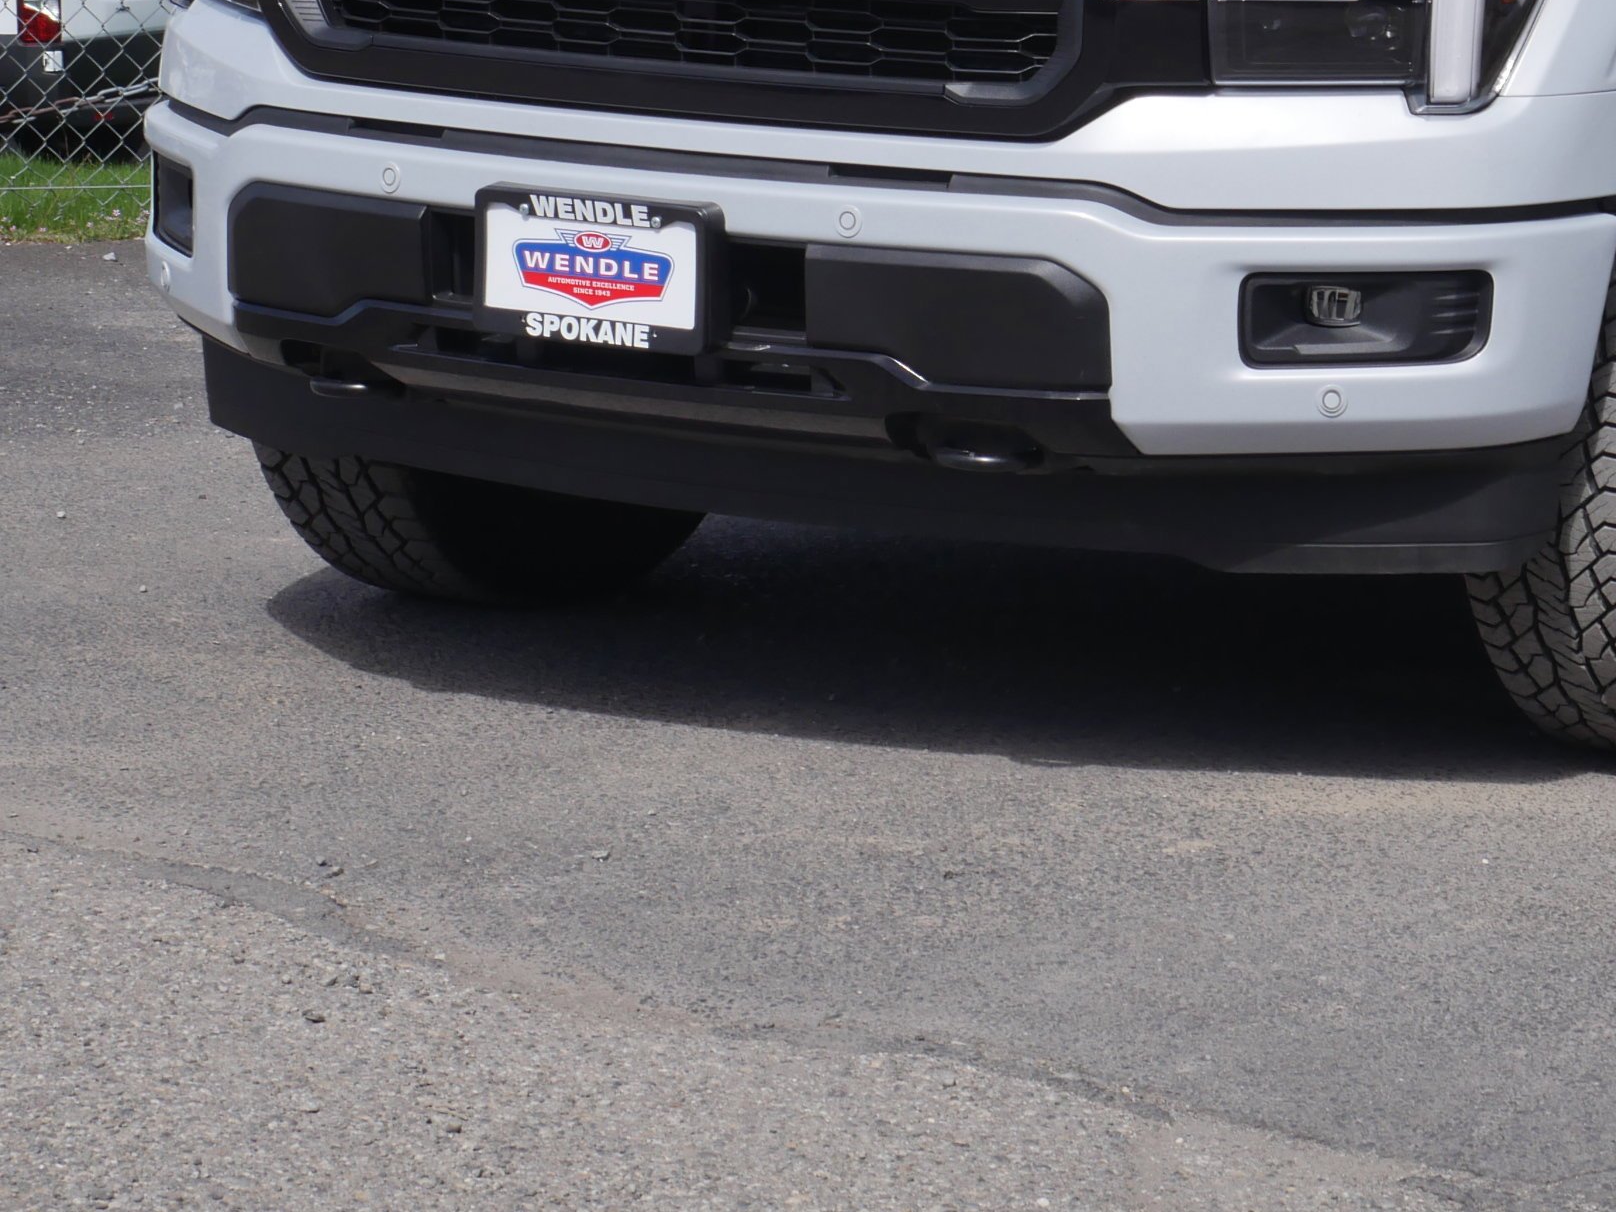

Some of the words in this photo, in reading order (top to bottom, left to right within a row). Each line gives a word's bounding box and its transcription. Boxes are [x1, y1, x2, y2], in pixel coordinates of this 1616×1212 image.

[529, 194, 651, 228] WENDLE
[523, 250, 659, 281] WENDLE
[547, 276, 591, 287] AUTOMOTIVE
[591, 281, 635, 291] EXCELLENCE
[572, 287, 593, 295] SINCE
[525, 312, 650, 349] SPOKANE
